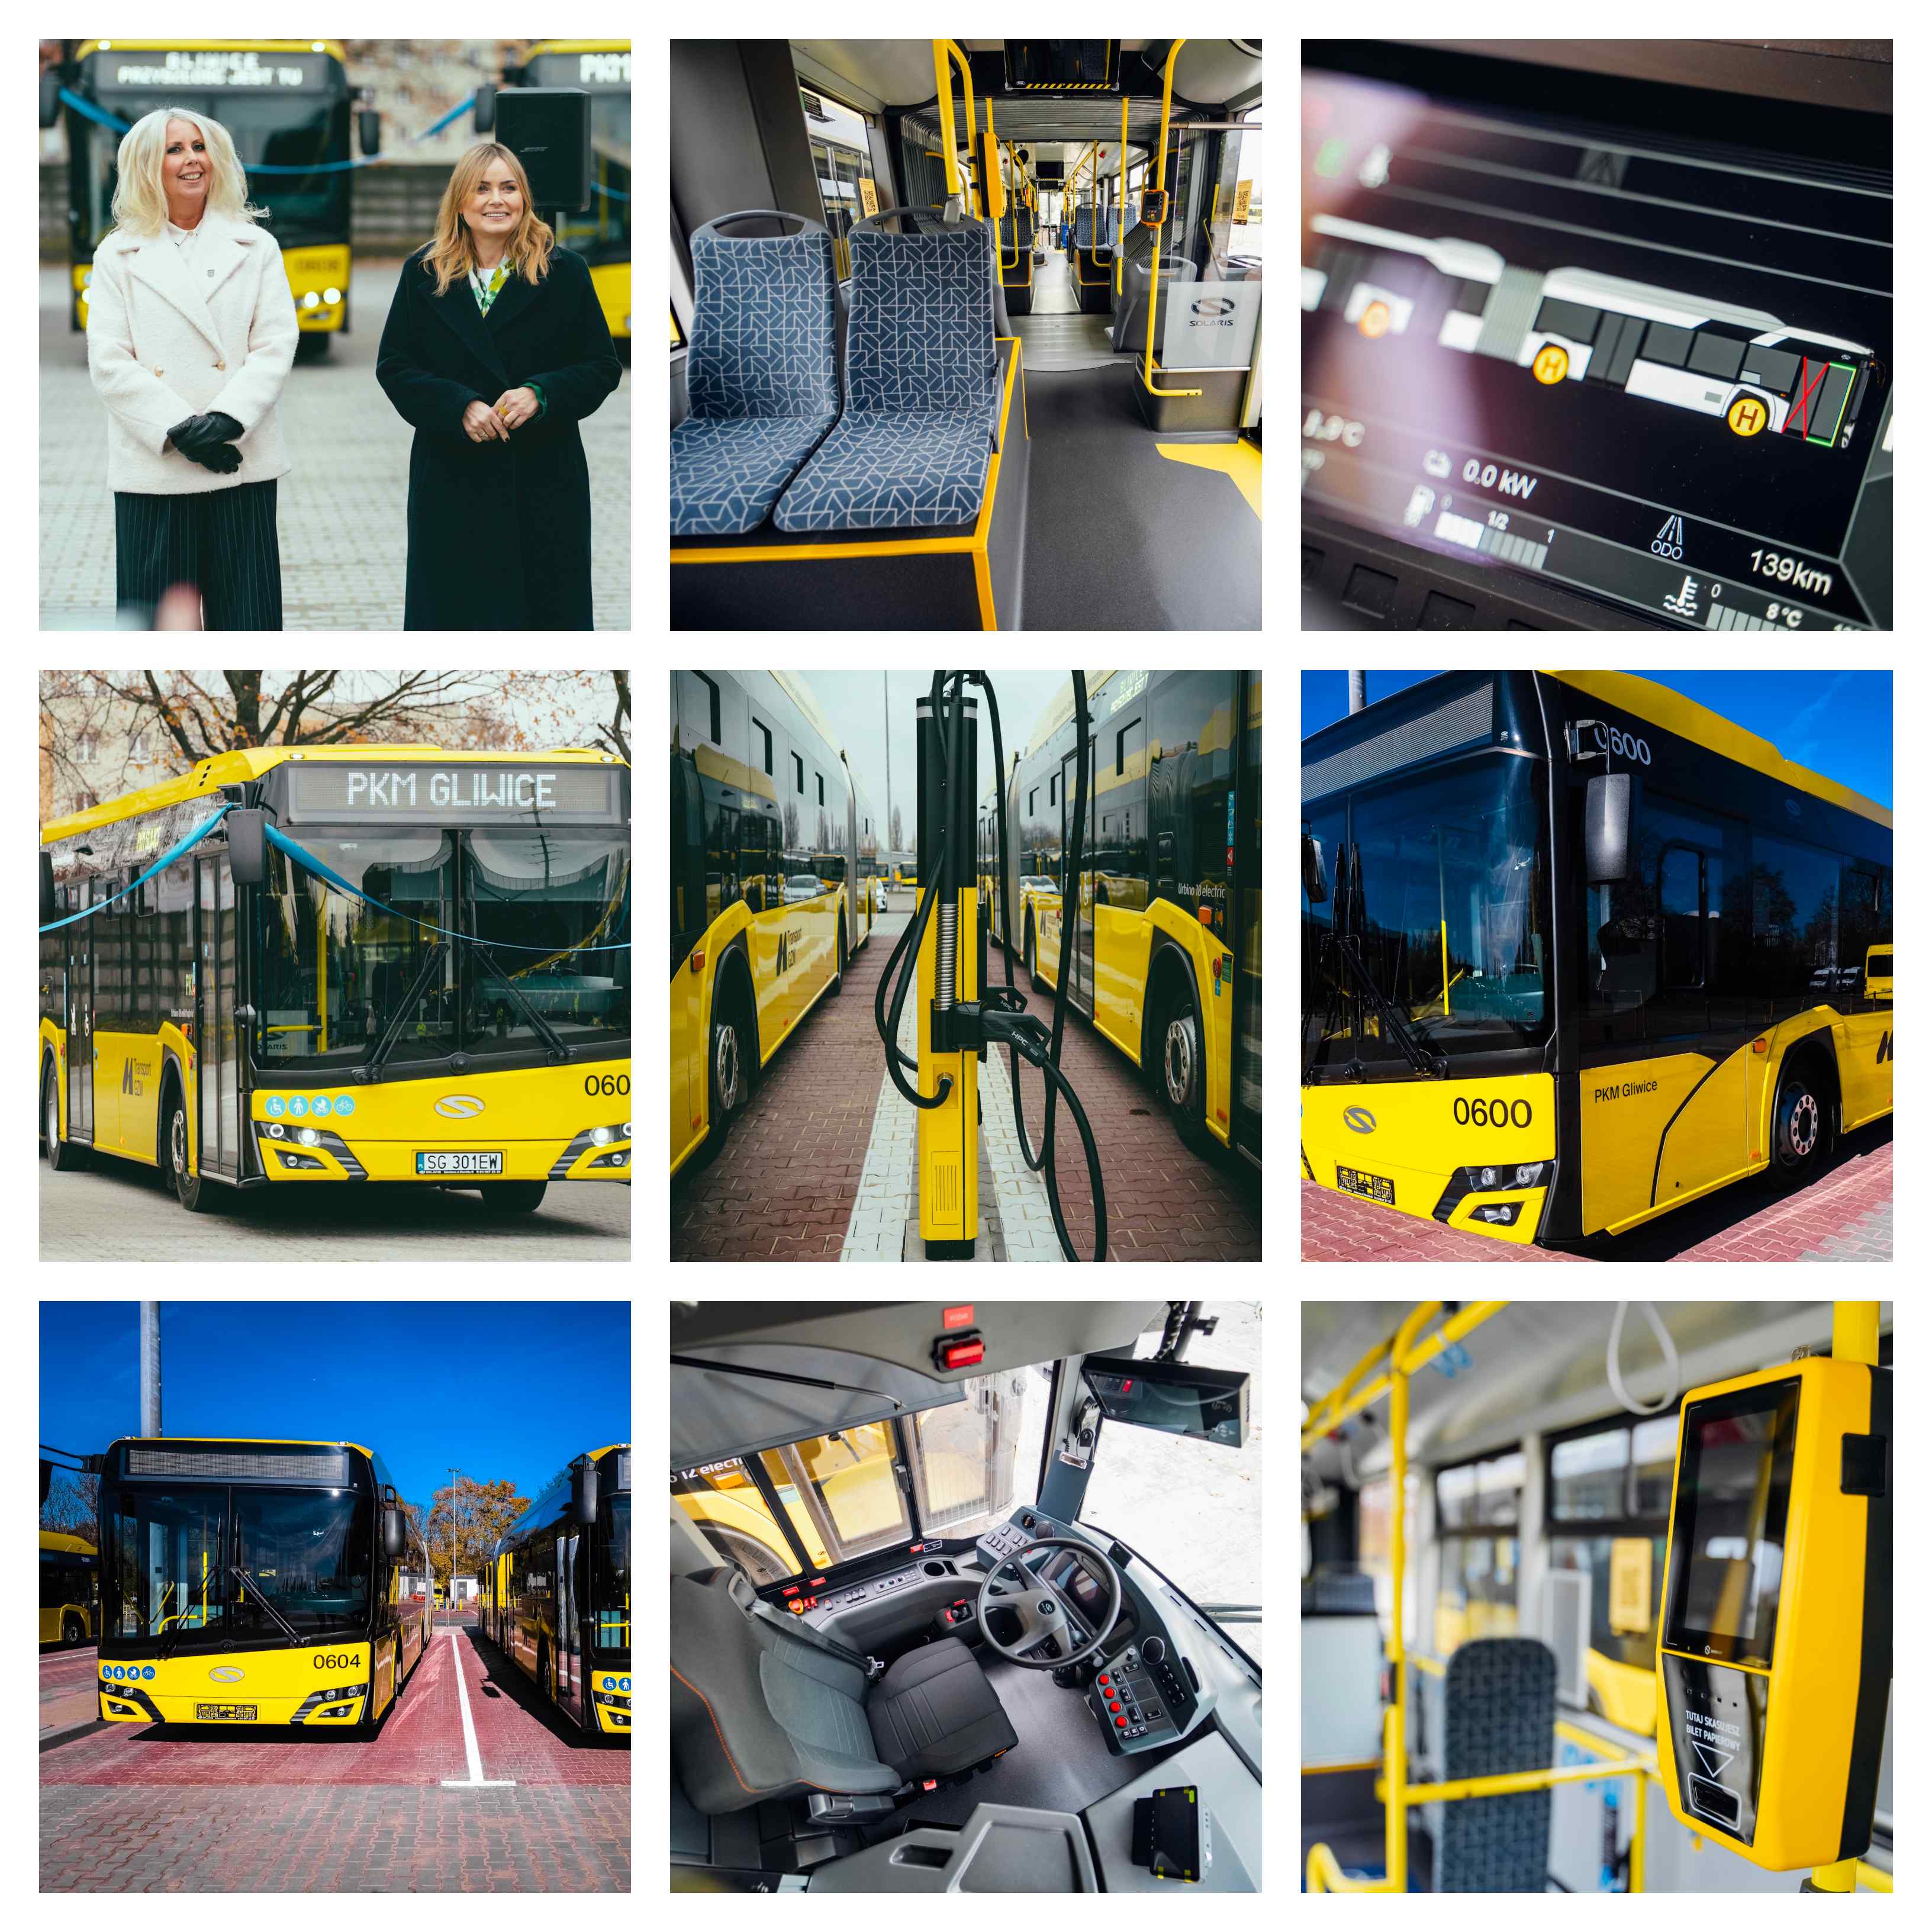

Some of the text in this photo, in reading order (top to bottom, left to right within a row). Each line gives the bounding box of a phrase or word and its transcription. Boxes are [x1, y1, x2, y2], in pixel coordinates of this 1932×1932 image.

[1463, 459, 1537, 500] 0.0 kW
[1487, 510, 1509, 531] 1/2
[1547, 529, 1555, 543] 1
[1651, 539, 1683, 560] ODO
[1750, 549, 1833, 596] 139km
[1711, 583, 1722, 598] 0
[1593, 726, 1651, 765] 0600
[347, 772, 556, 807] PKM GLIWICE
[1178, 883, 1226, 898] Urbino 18 electric
[1000, 1000, 1013, 1011] HPC
[1011, 1031, 1028, 1046] HPC
[584, 1074, 630, 1096] 060
[1595, 1079, 1657, 1104] PKM Gliwice
[1453, 1097, 1532, 1128] 0600
[427, 1155, 498, 1169] SG 301EW
[313, 1654, 360, 1669] 0604
[1686, 1709, 1741, 1737] TUTAJ SKASUJESZ
[1686, 1724, 1741, 1751] BILET PAPIEROWY
